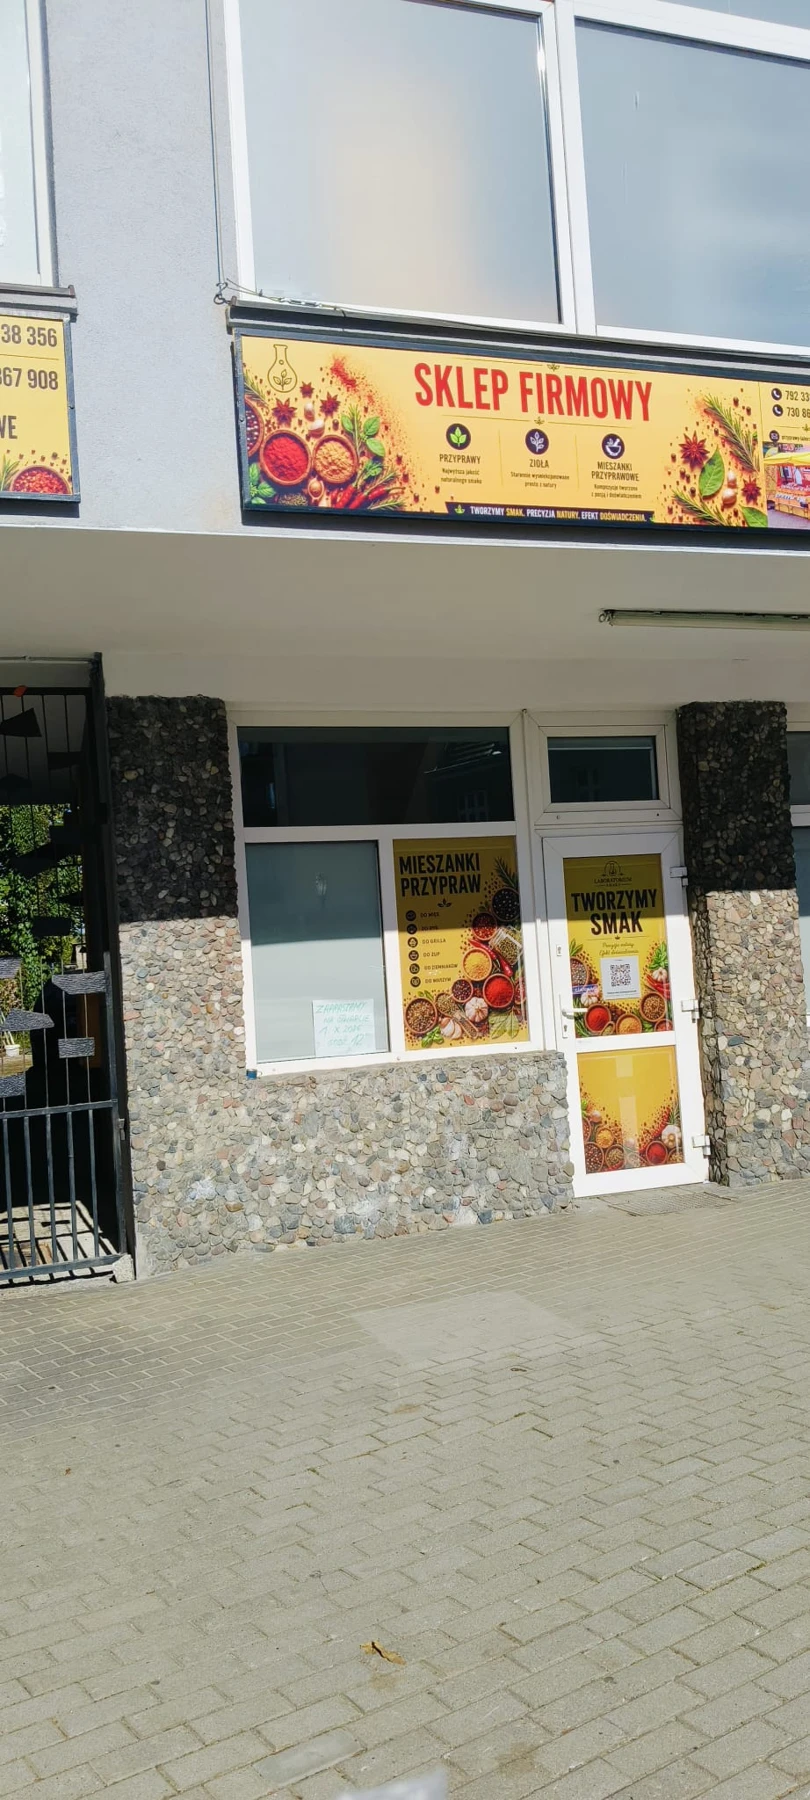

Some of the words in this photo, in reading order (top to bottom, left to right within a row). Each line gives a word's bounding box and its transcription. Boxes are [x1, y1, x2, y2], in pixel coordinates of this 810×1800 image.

[27, 326, 58, 347] 356
[28, 369, 59, 390] 908
[414, 362, 509, 411] SKLEP
[519, 371, 652, 422] FIRMOWY
[785, 390, 798, 401] 792
[786, 406, 800, 418] 730
[439, 453, 481, 464] PRZYPRAWY
[529, 458, 549, 468] ZIOŁA
[597, 461, 632, 471] MIESZANKI
[591, 470, 640, 481] PRZYPRAWOWE
[470, 505, 505, 516] TWORZYMY
[526, 508, 556, 518] PRECYZJA
[556, 510, 580, 519] NATURY.
[581, 510, 599, 520] EFEKT
[399, 852, 480, 875] MIESZANKI
[401, 874, 481, 897] PRZYPRAW
[570, 888, 657, 913] TWORZYMY
[590, 910, 643, 936] SMAK
